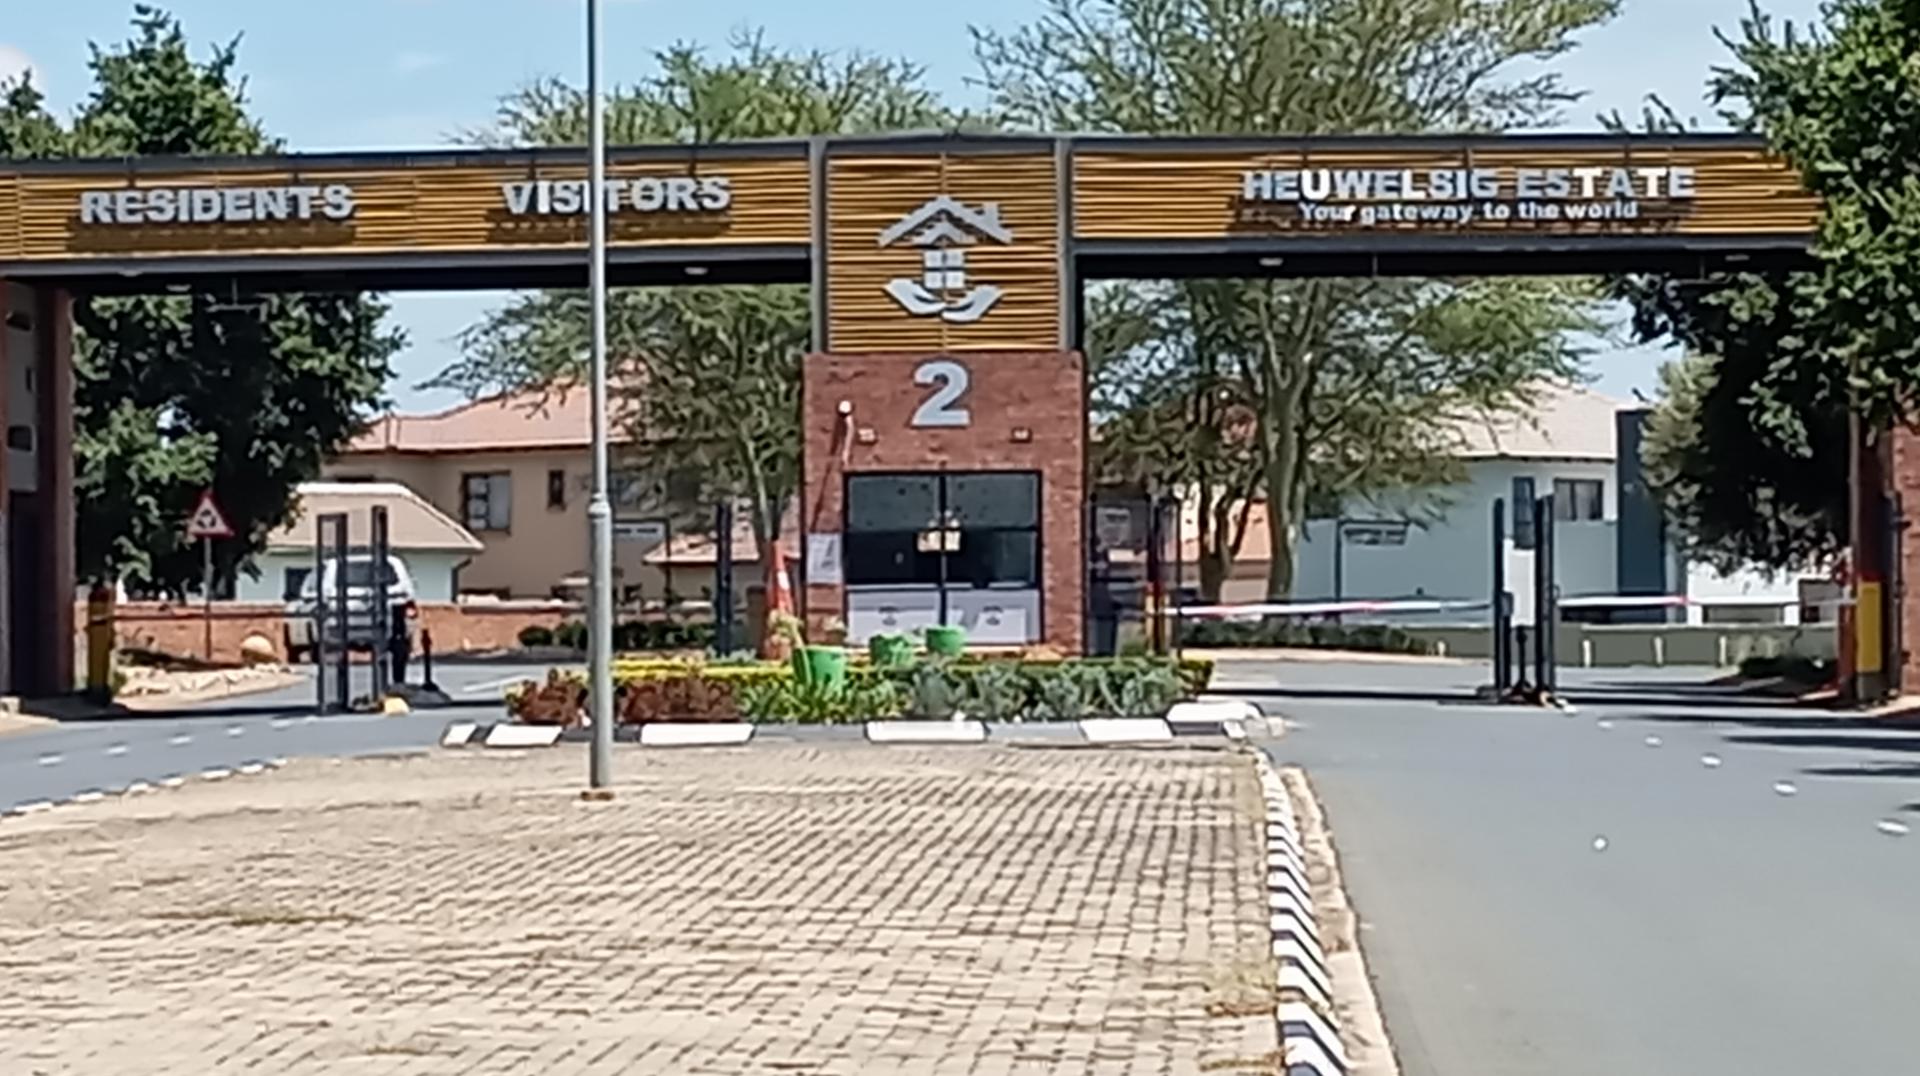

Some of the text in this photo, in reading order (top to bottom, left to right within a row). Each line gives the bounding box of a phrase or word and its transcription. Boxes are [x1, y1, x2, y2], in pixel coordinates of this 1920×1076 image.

[502, 177, 731, 214] VISITORS
[1243, 167, 1695, 200] HEUWELSIG ESTATE
[80, 185, 352, 223] RESIDENTS
[1300, 200, 1639, 225] Your gateway to the world
[911, 360, 970, 426] 2
